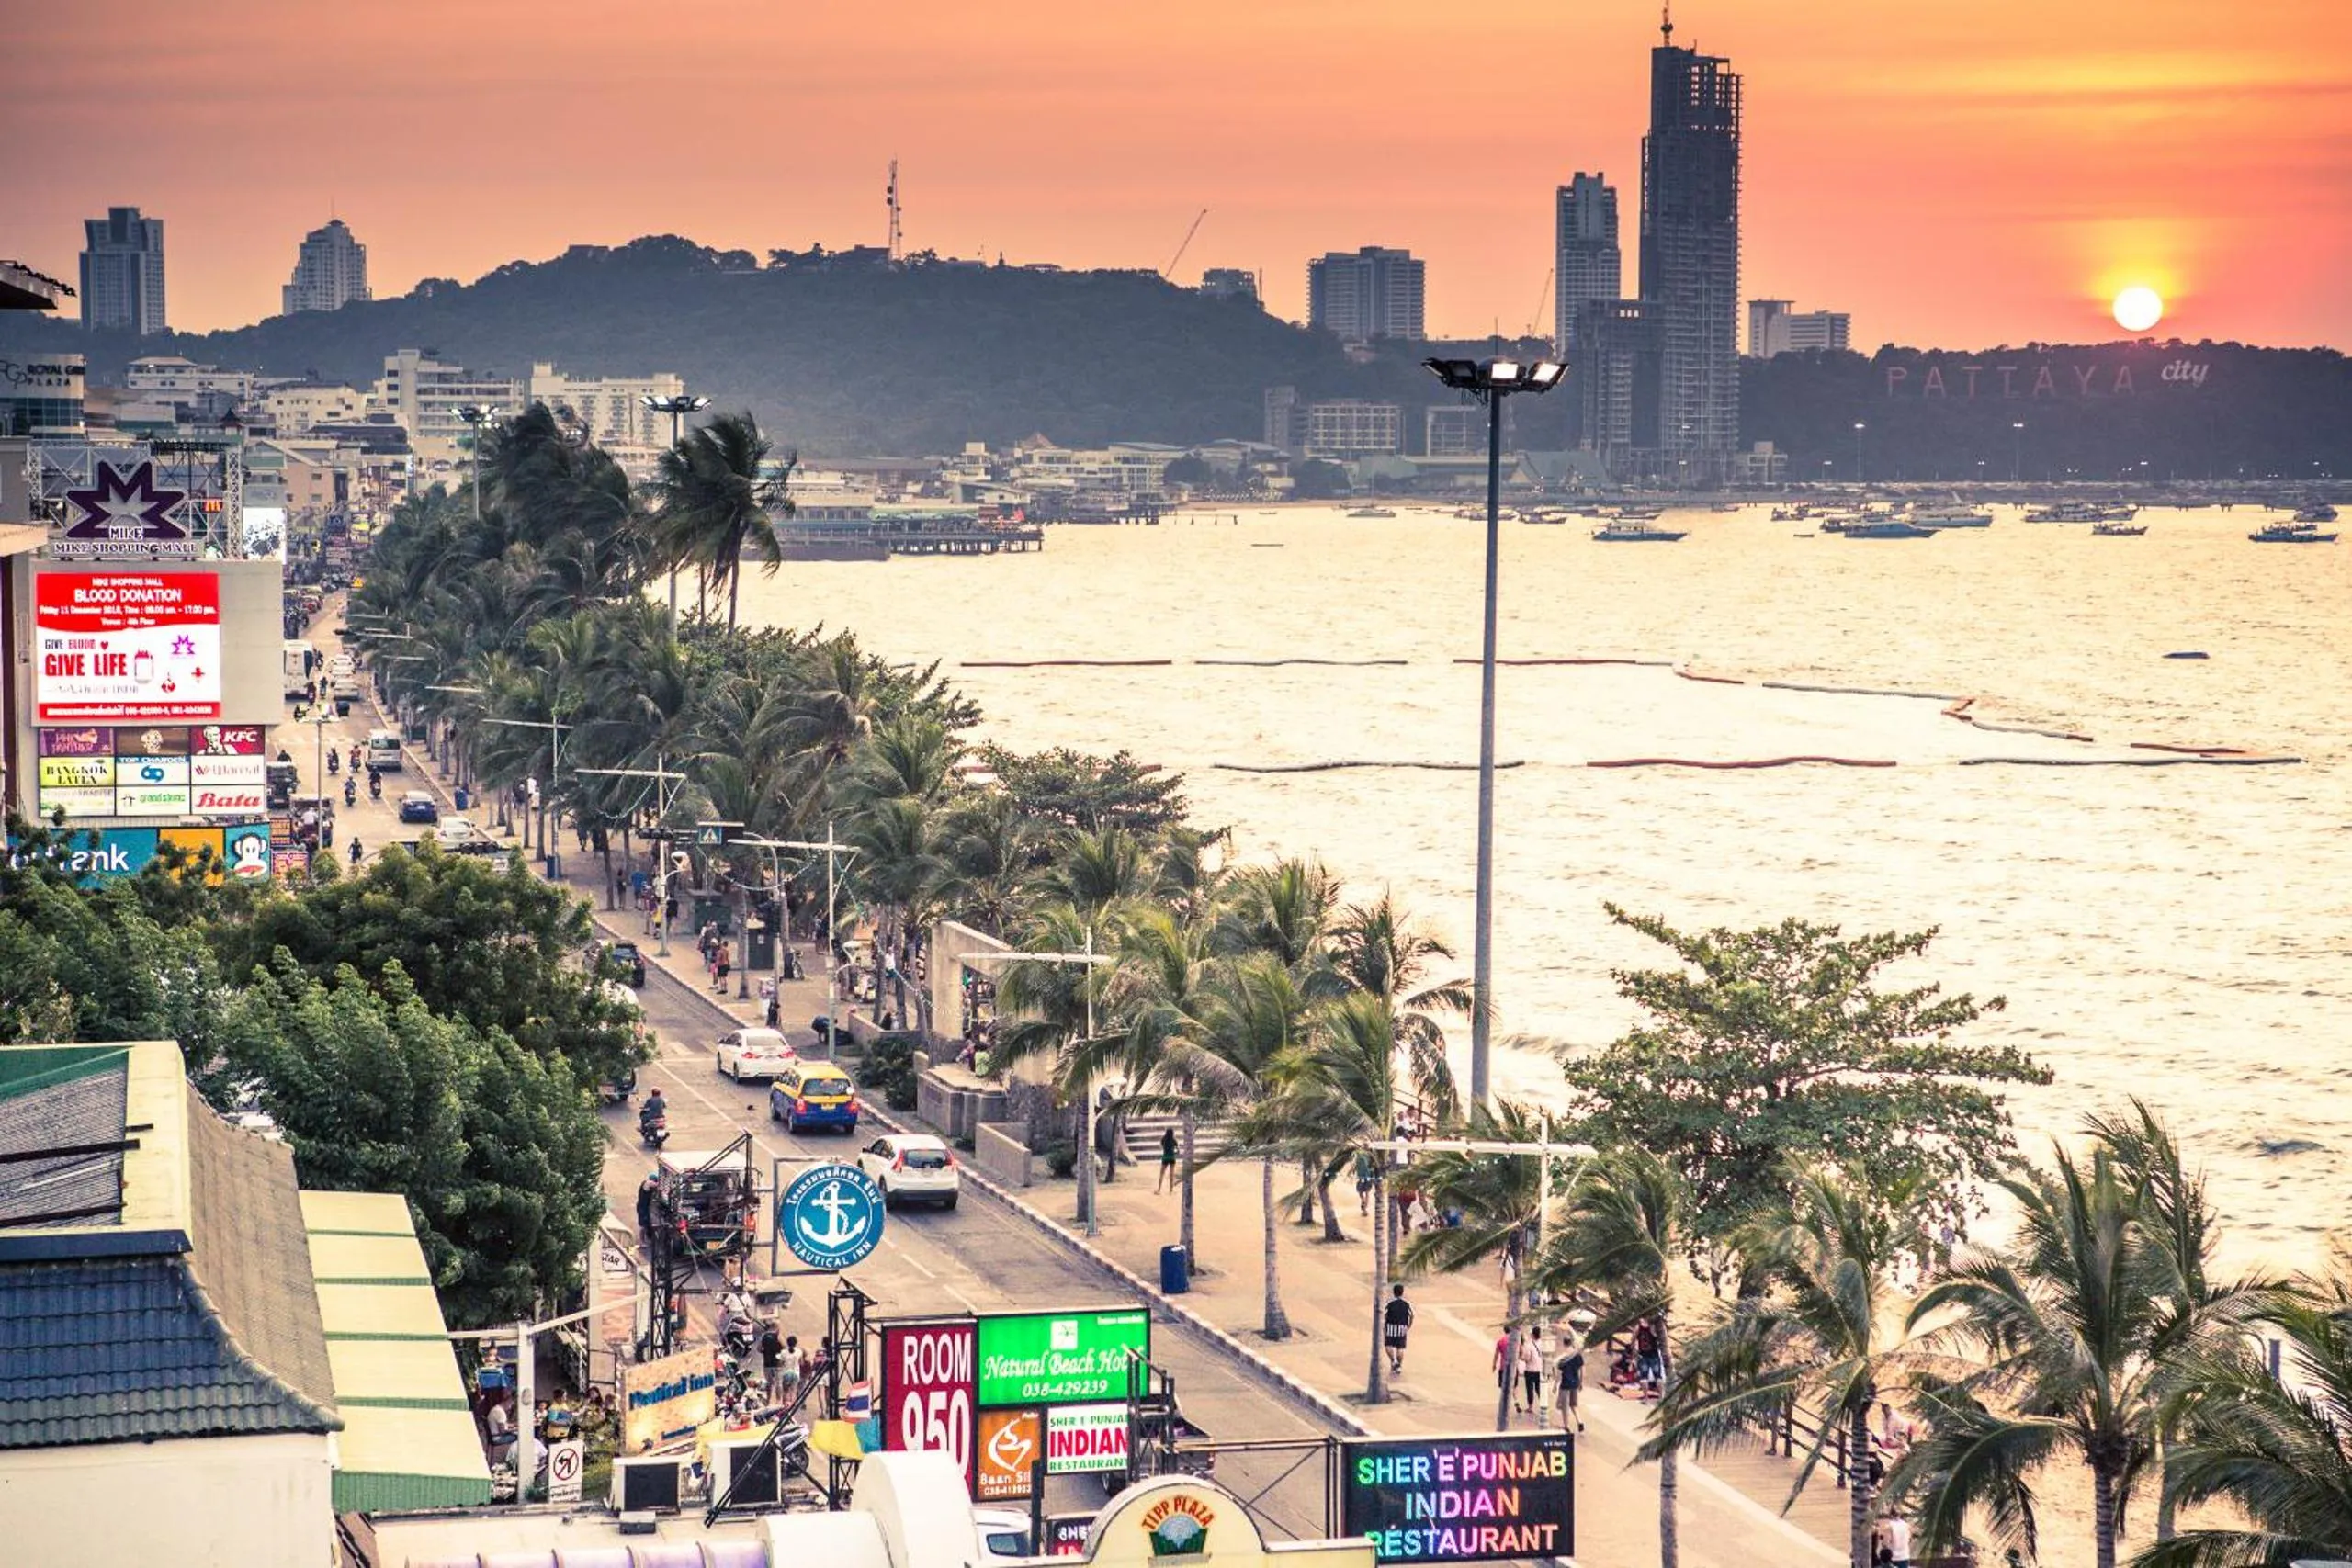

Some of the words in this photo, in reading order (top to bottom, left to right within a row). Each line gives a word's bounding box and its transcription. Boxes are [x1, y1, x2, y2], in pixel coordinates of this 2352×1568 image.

[28, 364, 62, 375] ROYAL
[1886, 367, 2135, 399] PATTAYA
[2161, 359, 2209, 388] city
[28, 378, 71, 386] PLAZA
[109, 526, 143, 540] MIKE
[55, 542, 90, 553] MIKE
[93, 542, 159, 553] SHOPPING
[161, 542, 197, 553] MALL
[74, 589, 116, 602] BLOOD
[120, 589, 182, 603] DONATION
[45, 639, 63, 649] GIVE
[45, 654, 85, 676] GIVE
[94, 654, 127, 676] LIFE
[224, 730, 257, 742] KFC
[47, 766, 107, 775] BANGKOK
[196, 793, 262, 807] Bata
[792, 1241, 849, 1267] NAUTICAL
[852, 1241, 872, 1260] INN
[903, 1332, 971, 1385] ROOM
[984, 1350, 1049, 1380] Natural
[1049, 1347, 1096, 1375] Beach
[902, 1388, 970, 1477] 950
[1050, 1416, 1076, 1427] SHER
[1050, 1427, 1129, 1457] INDIAN
[1358, 1456, 1430, 1485] SHER
[1463, 1450, 1567, 1481] PUNJAB
[1142, 1501, 1169, 1529] TIPP
[1173, 1496, 1215, 1527] PLAZA
[1406, 1488, 1519, 1520] INDIAN
[1364, 1523, 1559, 1557] RESTAURANT
